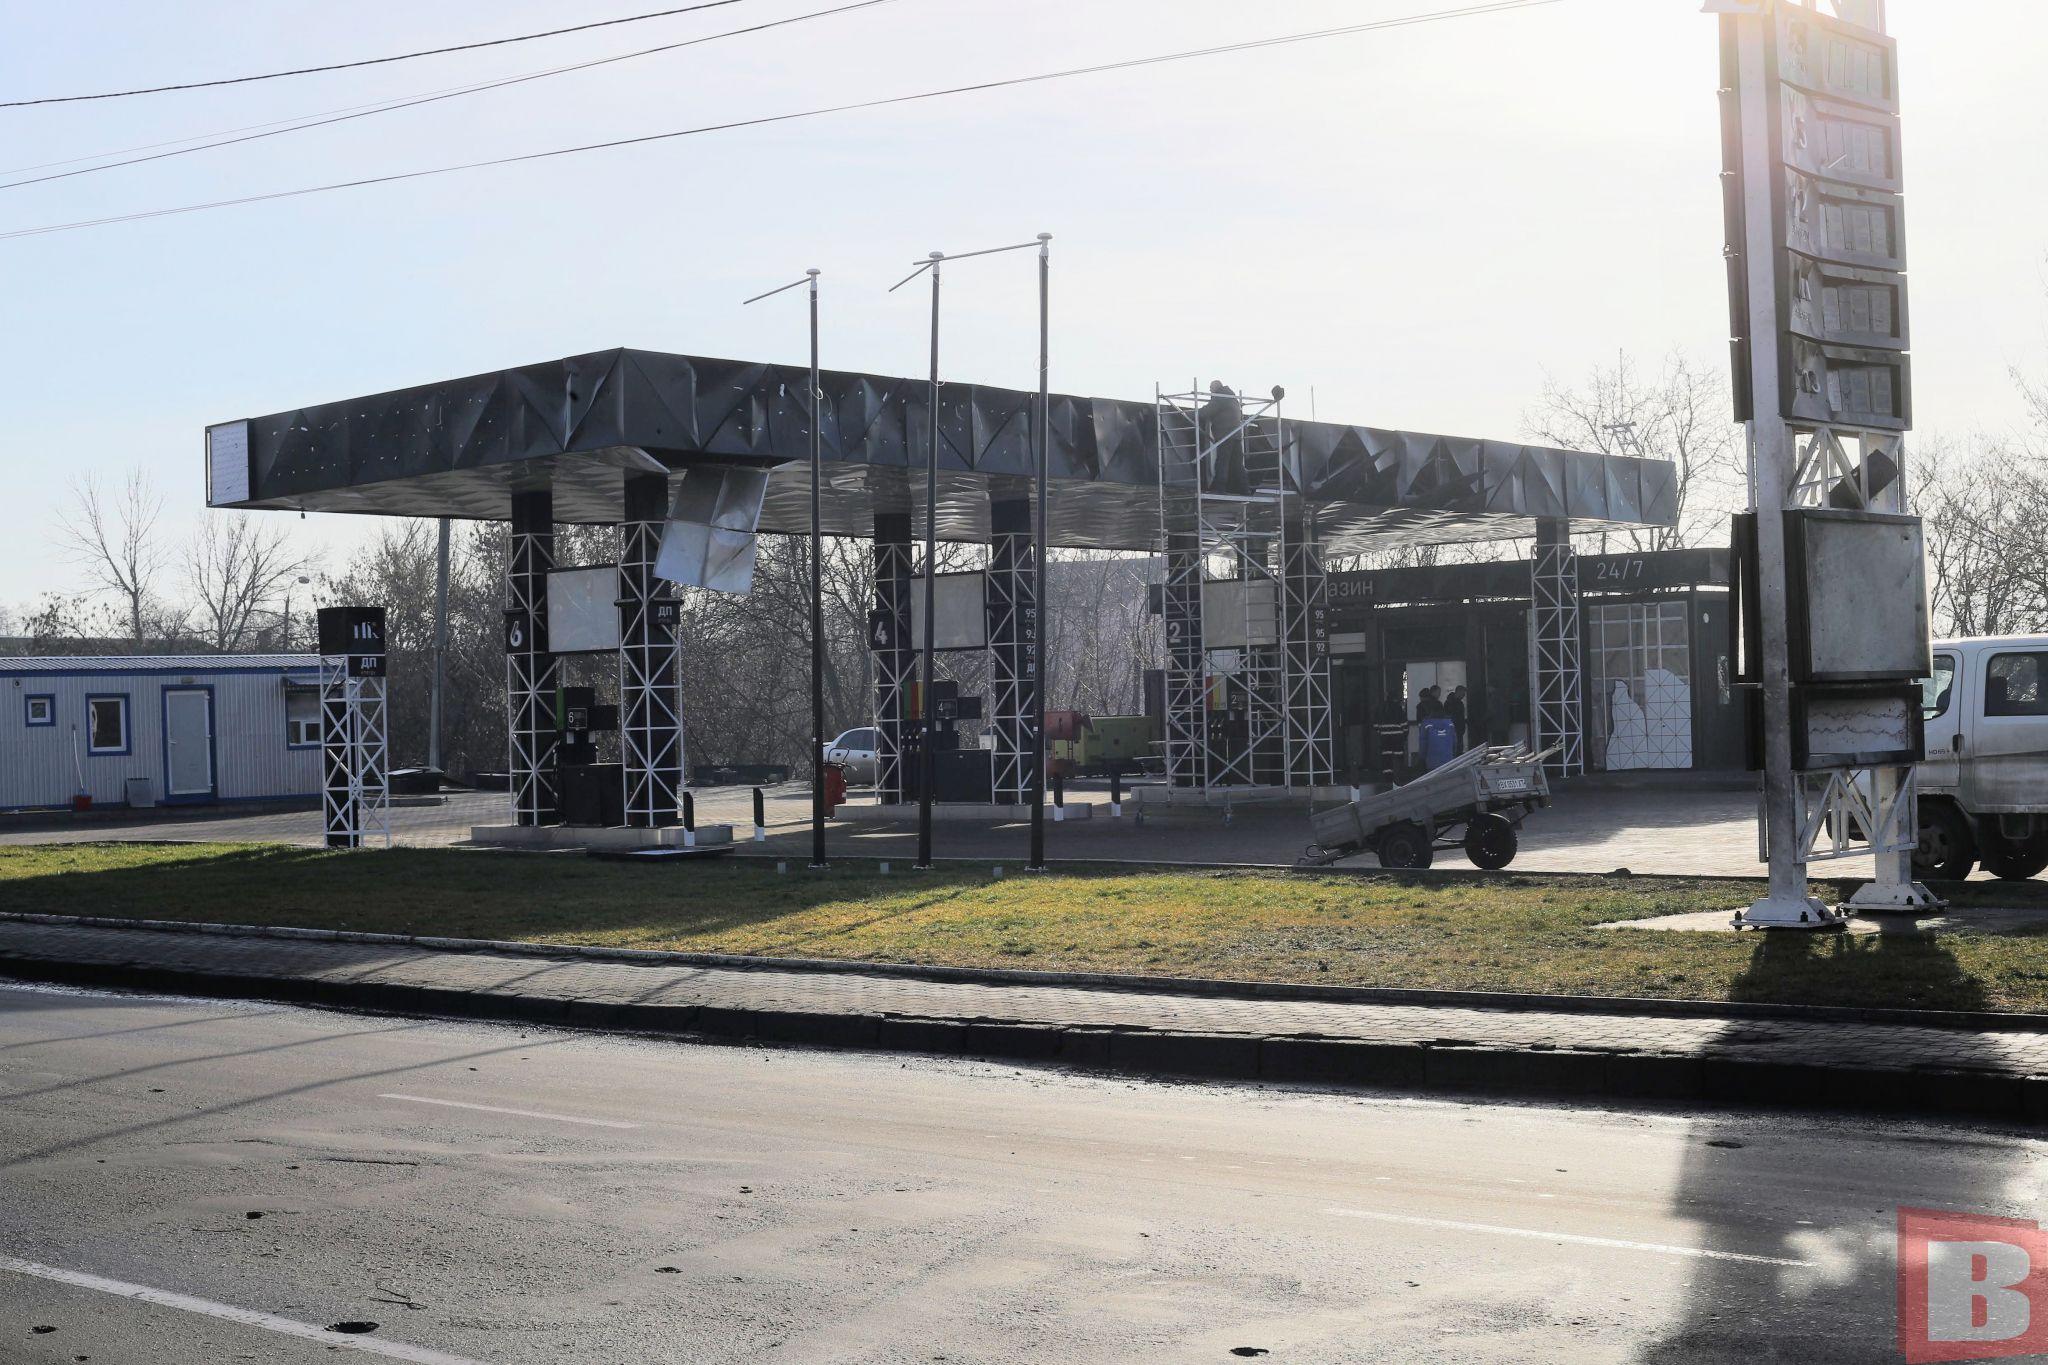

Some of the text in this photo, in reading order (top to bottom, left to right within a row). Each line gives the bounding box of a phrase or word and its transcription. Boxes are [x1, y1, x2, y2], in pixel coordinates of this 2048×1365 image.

[1597, 558, 1643, 580] 24/7
[1320, 580, 1374, 597] азин
[658, 606, 673, 618] ДП
[1315, 609, 1325, 619] 95
[510, 620, 523, 647] 6
[874, 621, 888, 645] 4
[1168, 621, 1182, 644] 2
[1315, 628, 1325, 638] 95
[1316, 643, 1326, 652] 92
[360, 657, 377, 669] ДП
[568, 711, 575, 724] 6
